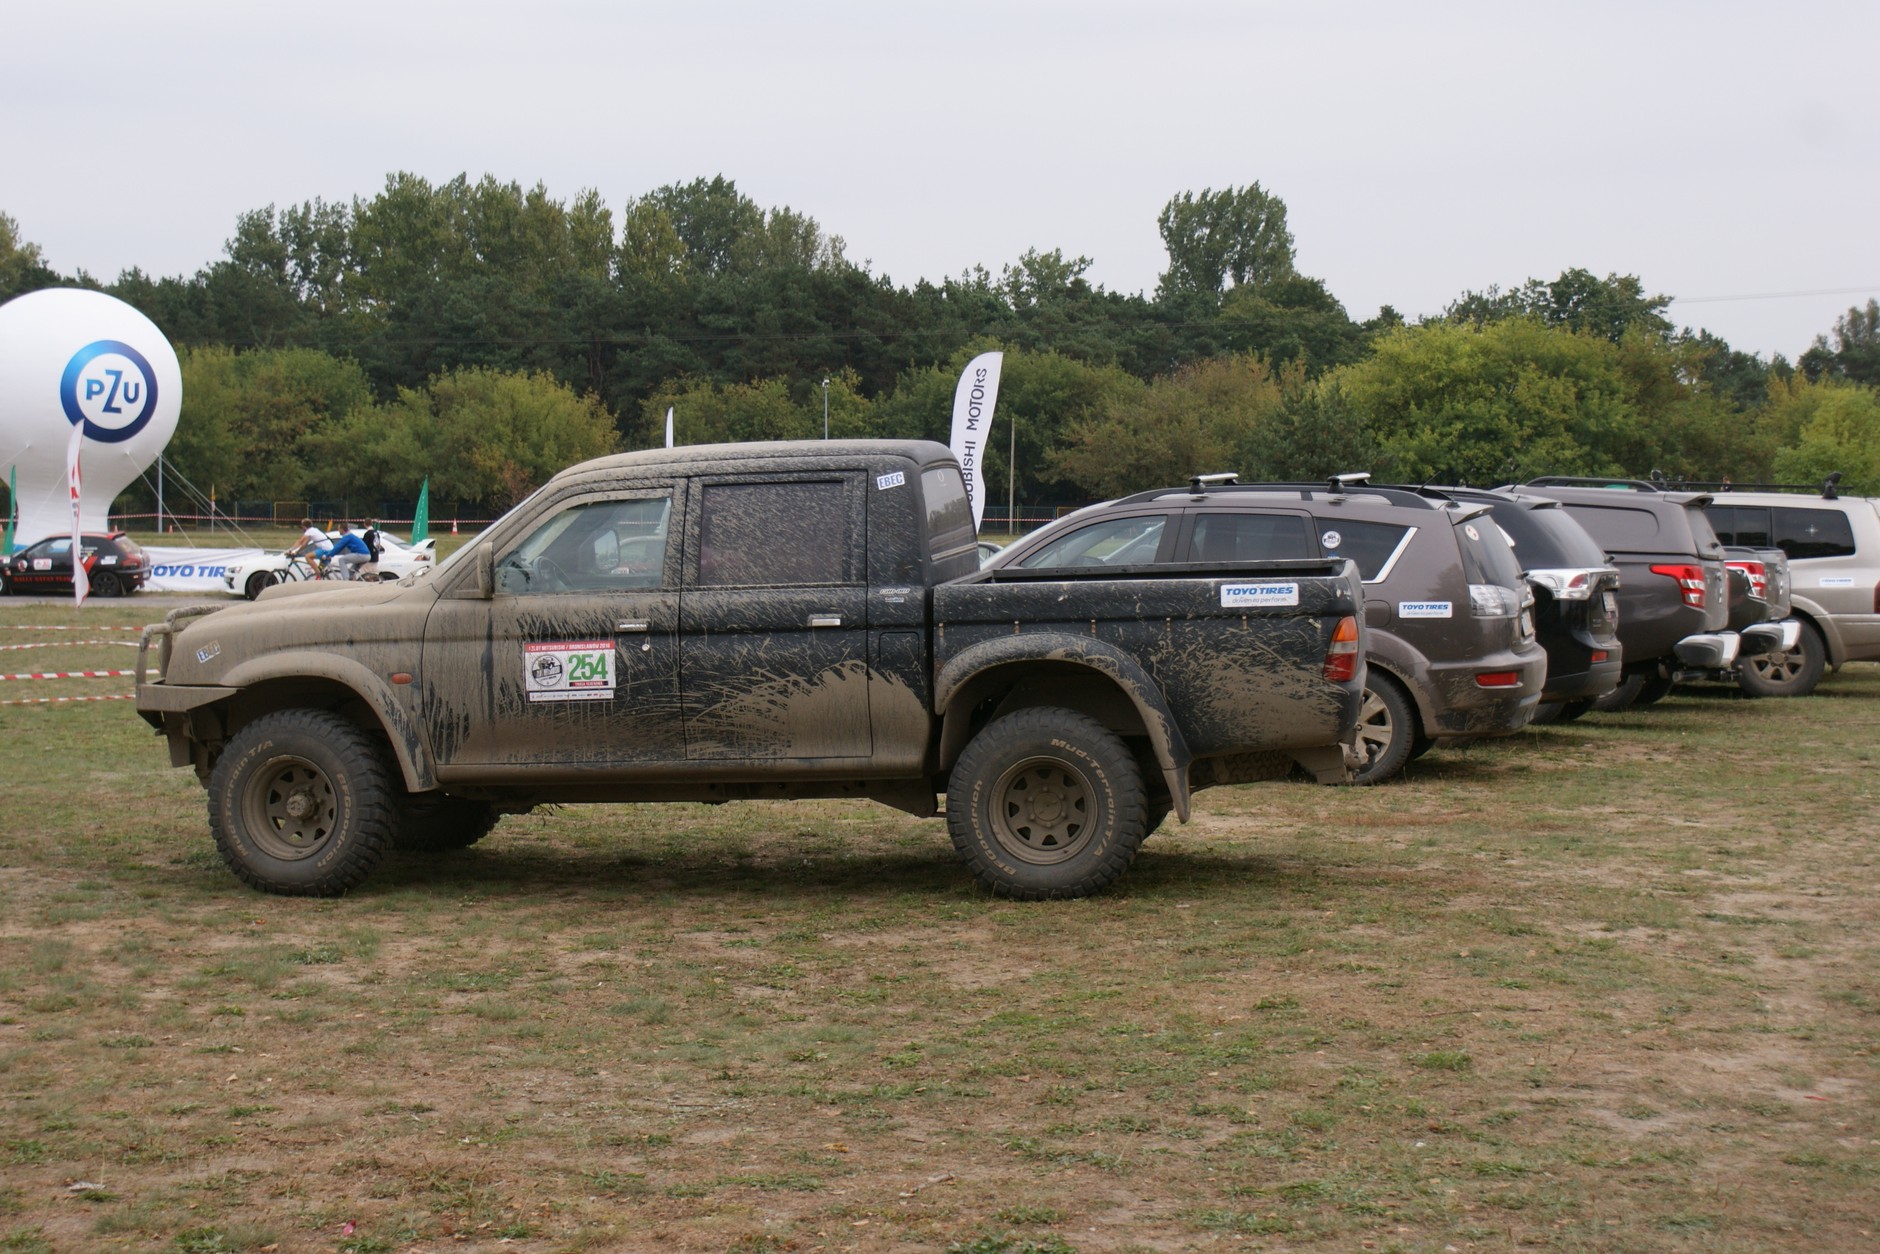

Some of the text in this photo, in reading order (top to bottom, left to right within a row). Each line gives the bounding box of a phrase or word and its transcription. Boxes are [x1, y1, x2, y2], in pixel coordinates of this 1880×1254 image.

[86, 369, 140, 414] PZU
[966, 368, 987, 431] MOTORS
[879, 473, 903, 489] EBEC
[1226, 586, 1293, 596] TOYO TIRES
[568, 653, 608, 681] 254
[1050, 738, 1116, 826] Mud-Terrain
